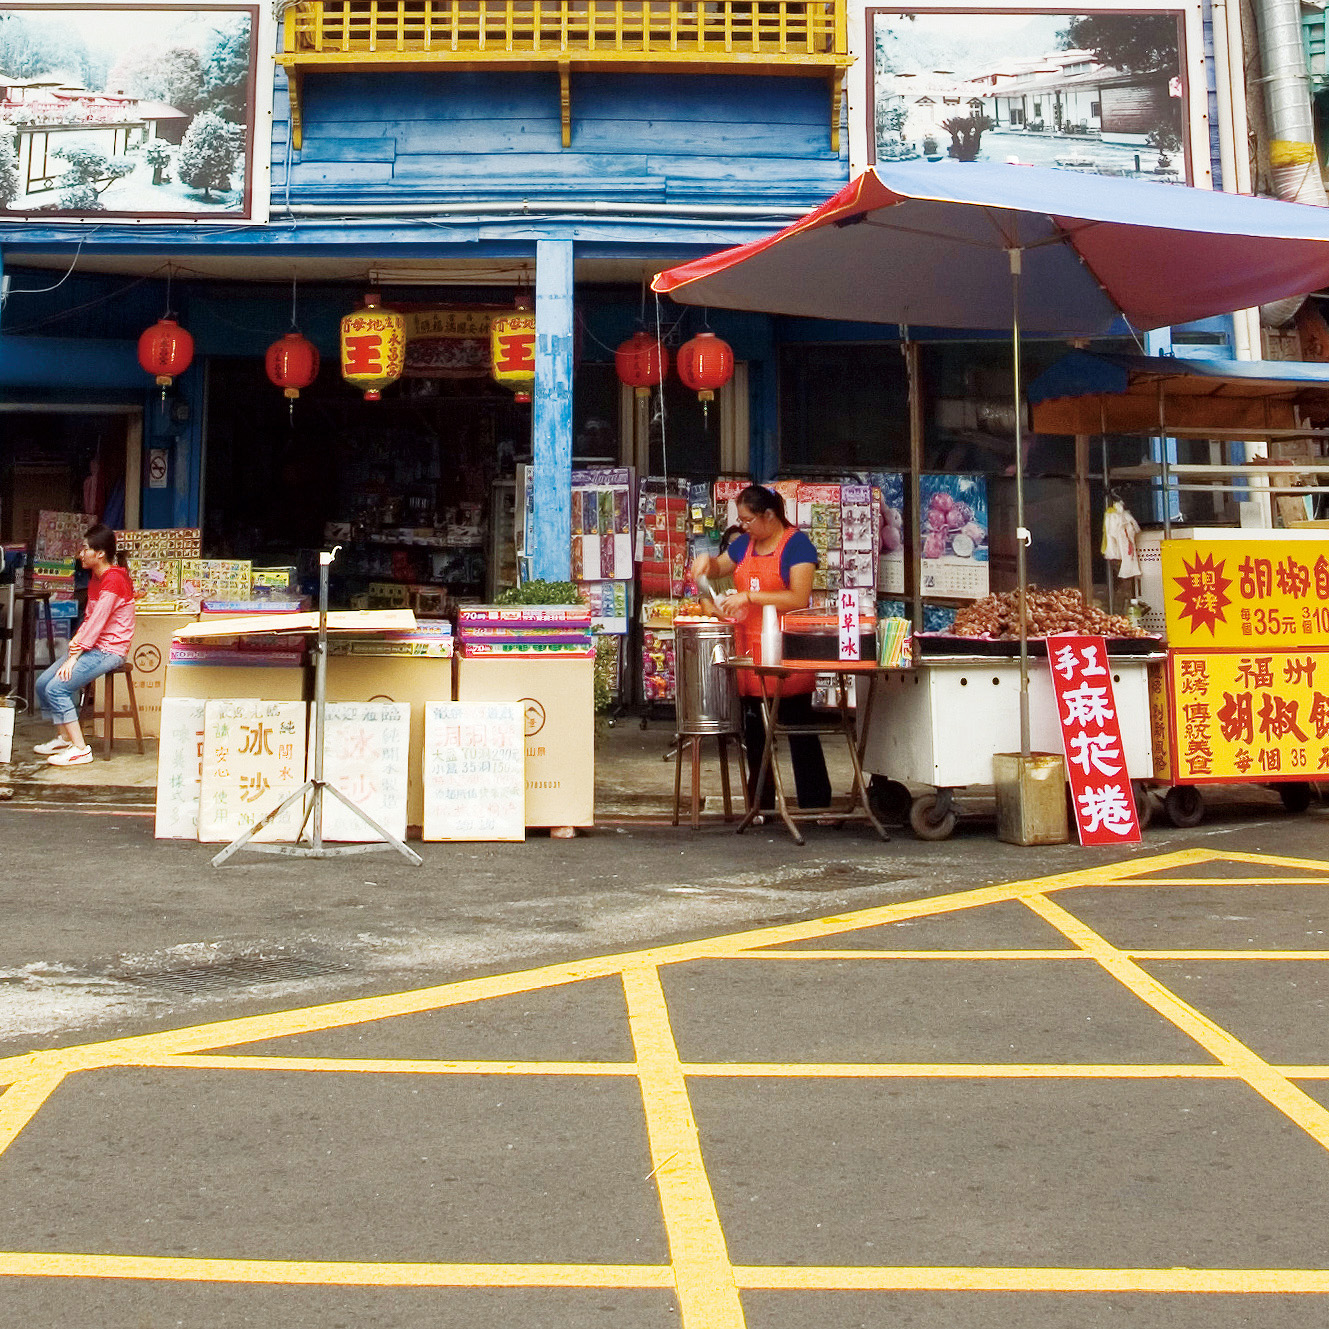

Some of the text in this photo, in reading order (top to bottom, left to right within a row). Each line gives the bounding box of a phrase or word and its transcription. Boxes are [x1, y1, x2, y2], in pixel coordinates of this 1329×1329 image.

[841, 593, 858, 657] 仙草冰
[1234, 656, 1317, 690] 福州
[238, 722, 274, 803] 冰沙
